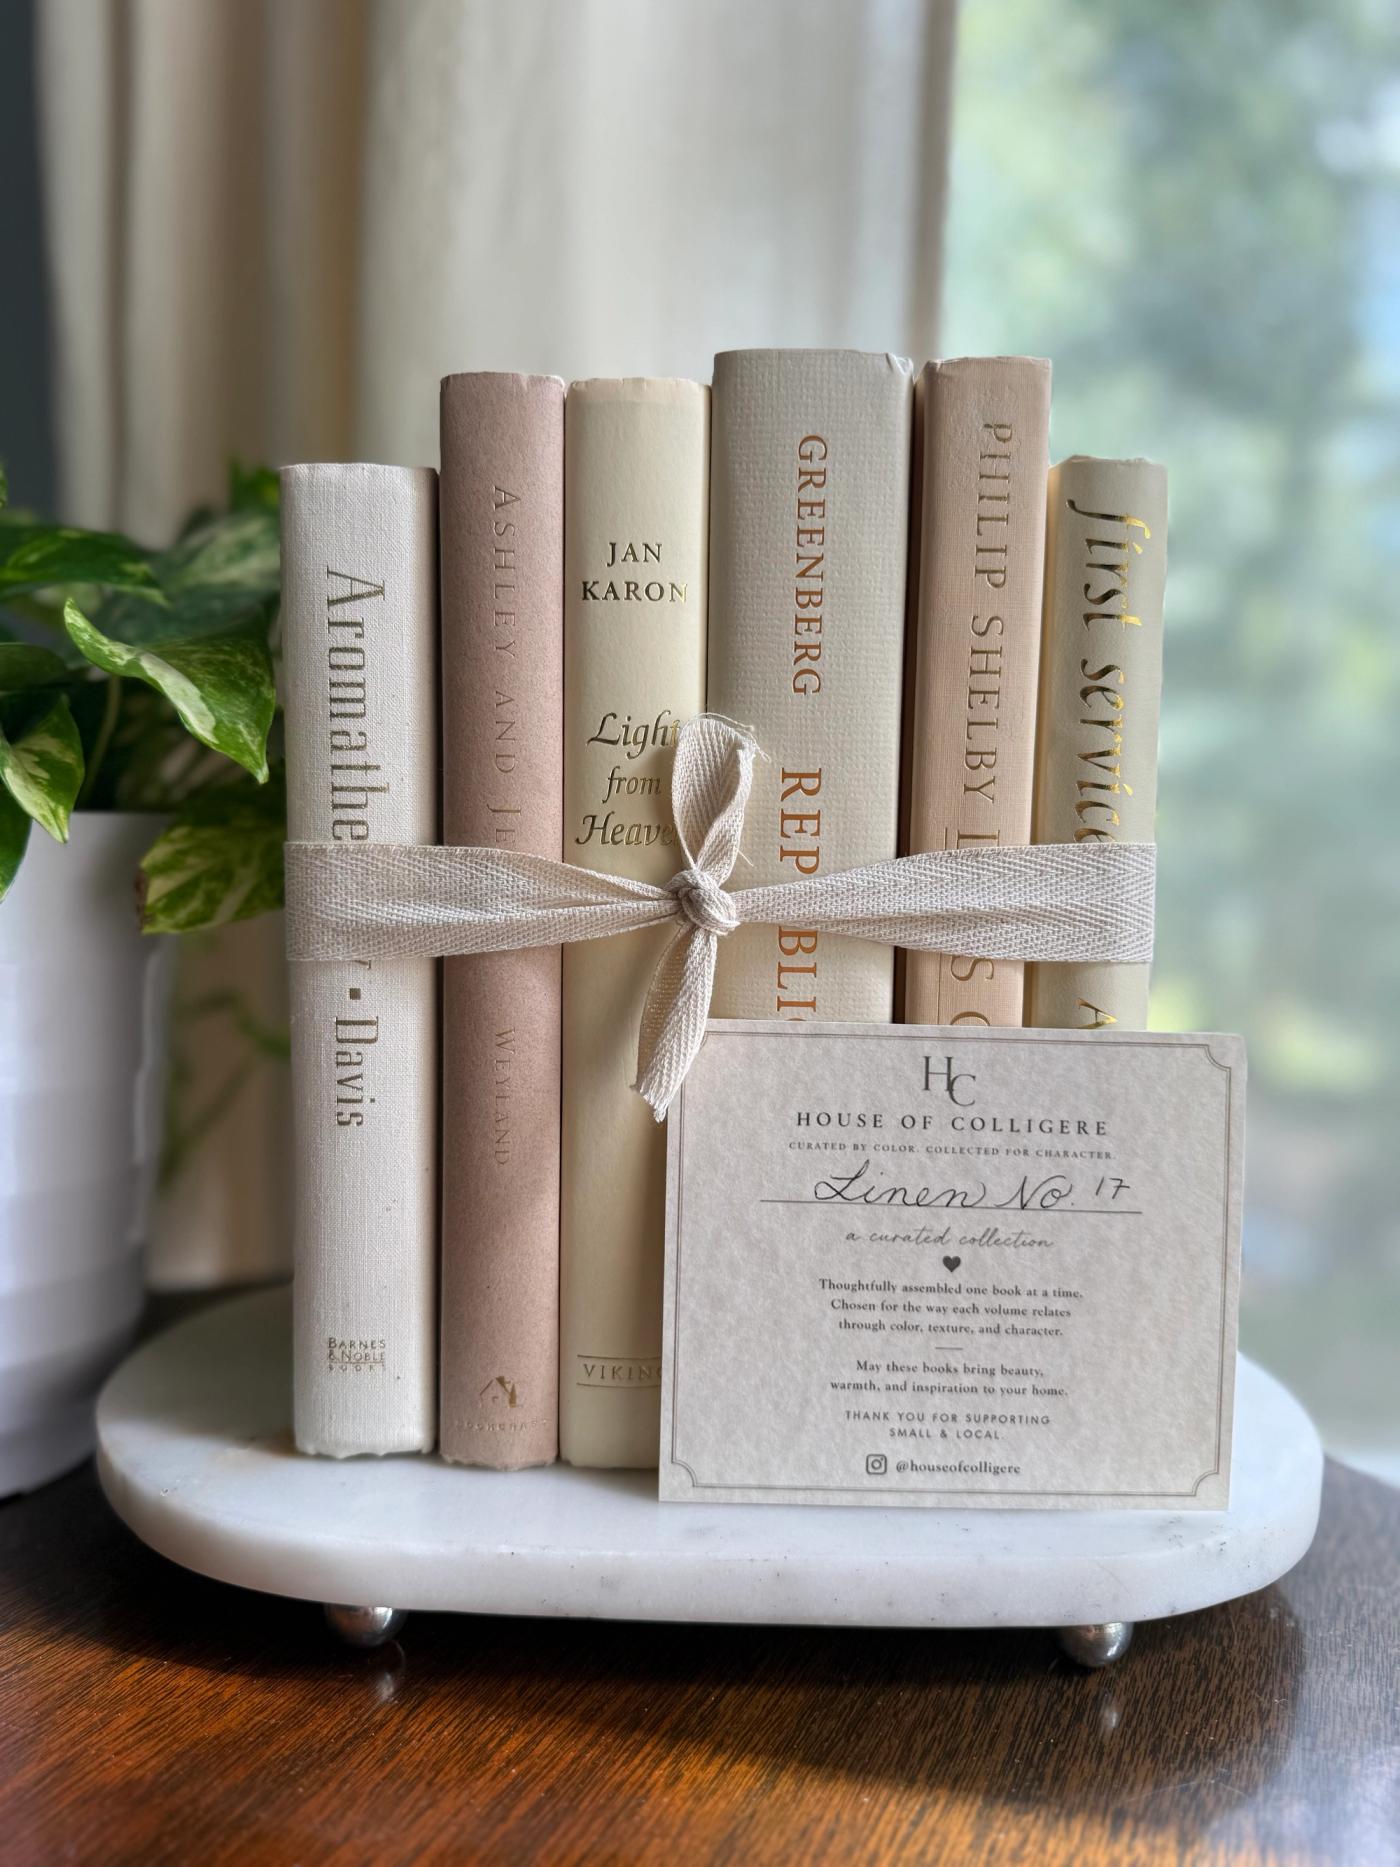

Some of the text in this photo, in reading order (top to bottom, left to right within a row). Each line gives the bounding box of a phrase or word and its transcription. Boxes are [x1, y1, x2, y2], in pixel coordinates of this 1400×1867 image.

[974, 423, 1013, 590] PHILIP
[607, 542, 662, 567] JAN
[792, 434, 828, 695] GREENBERG
[1065, 498, 1151, 632] first
[581, 581, 689, 602] KARON
[486, 486, 522, 850] ASHLEY AND JE
[963, 615, 1005, 804] SHELBY
[586, 709, 680, 760] Light
[601, 766, 662, 804] from
[574, 811, 680, 846] Heave
[776, 767, 822, 1021] REPBLI
[335, 1016, 379, 1127] Davis
[494, 1027, 516, 1166] WEYLAND
[796, 1111, 1108, 1137] HOUSE OF COLLIGERE
[789, 1141, 1117, 1161] CURATED BY COLOR. COLLECTED FOR CHARACTER.
[814, 1158, 1130, 1211] Linen No. 17
[846, 1226, 1055, 1249] a curated collection
[818, 1278, 1084, 1299] Thoughtfully assembled one book at a time.
[831, 1299, 1072, 1318] Chosen for the way each volume relates
[838, 1318, 886, 1333] through
[978, 1323, 1001, 1335] and
[1004, 1324, 1064, 1337] character.
[328, 1337, 386, 1349] BARNES
[856, 1360, 1044, 1378] May these books bring beauty,
[830, 1380, 1069, 1398] warmth, and inspiration to your home.
[845, 1410, 1051, 1426] THANK YOU FOR SUPPORTING
[888, 1427, 932, 1439] SMALL
[939, 1429, 949, 1439] &
[895, 1459, 1022, 1476] @houseofcolligere
